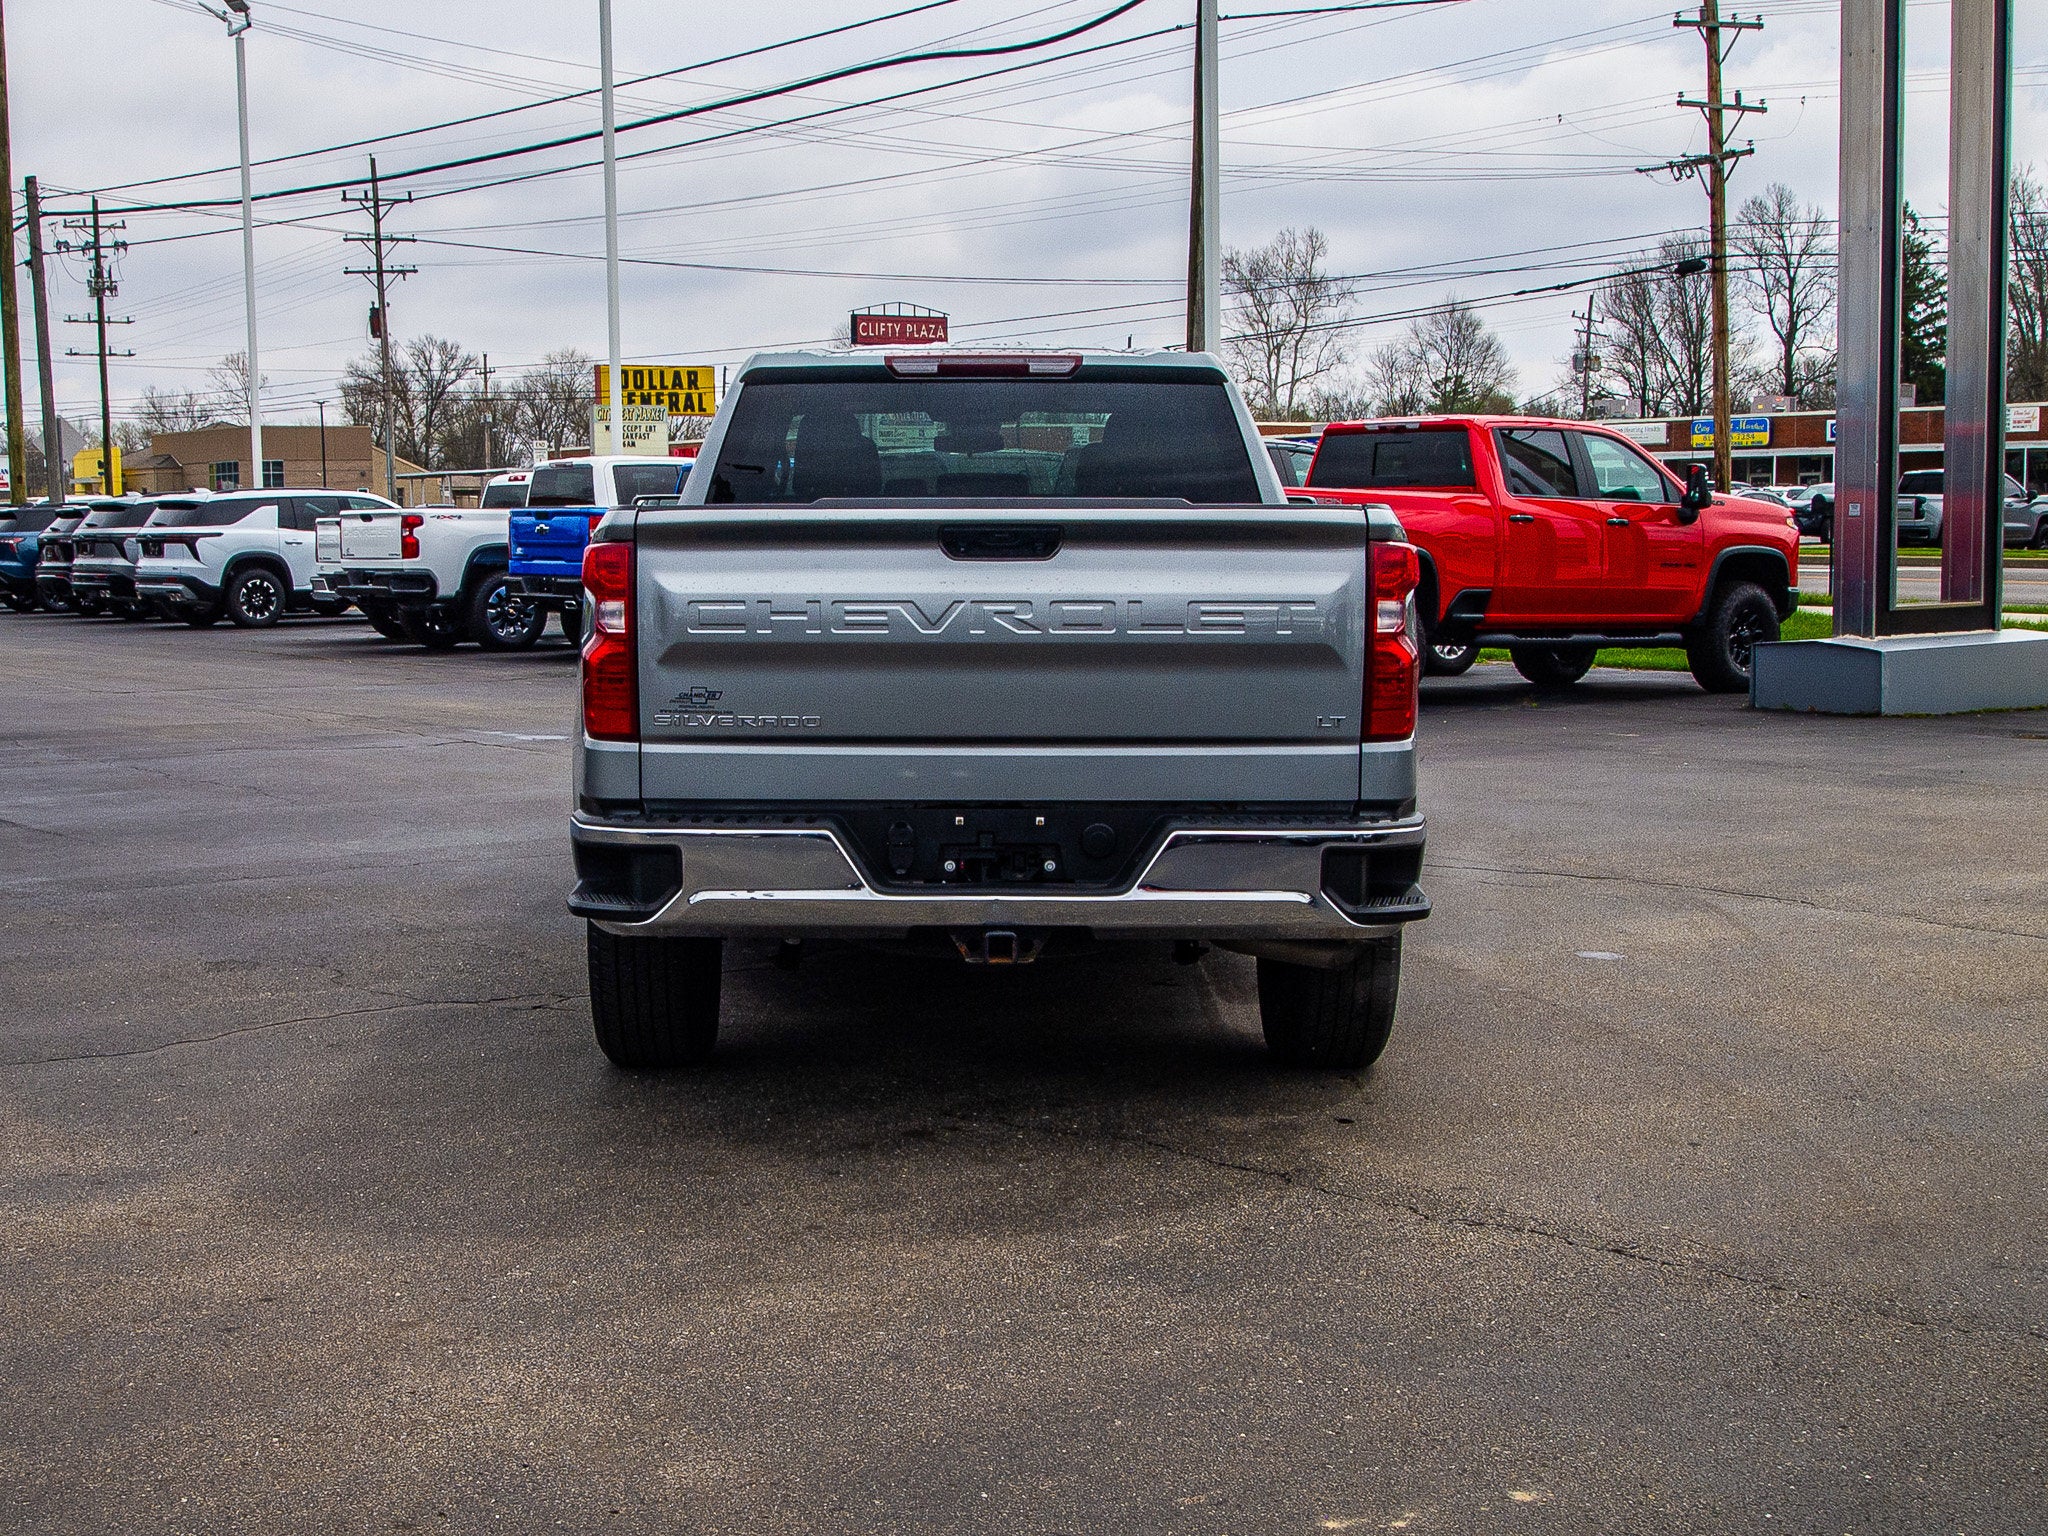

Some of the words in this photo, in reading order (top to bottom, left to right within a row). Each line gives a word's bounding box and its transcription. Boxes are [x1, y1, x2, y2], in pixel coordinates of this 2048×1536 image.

[859, 322, 900, 337] CLIFTY
[906, 323, 945, 339] PLAZA
[626, 391, 707, 412] ENERAL
[635, 406, 666, 421] MARKET
[687, 600, 1316, 635] CHEVROLET
[653, 714, 821, 727] SILVERADO
[1316, 715, 1347, 728] LT
